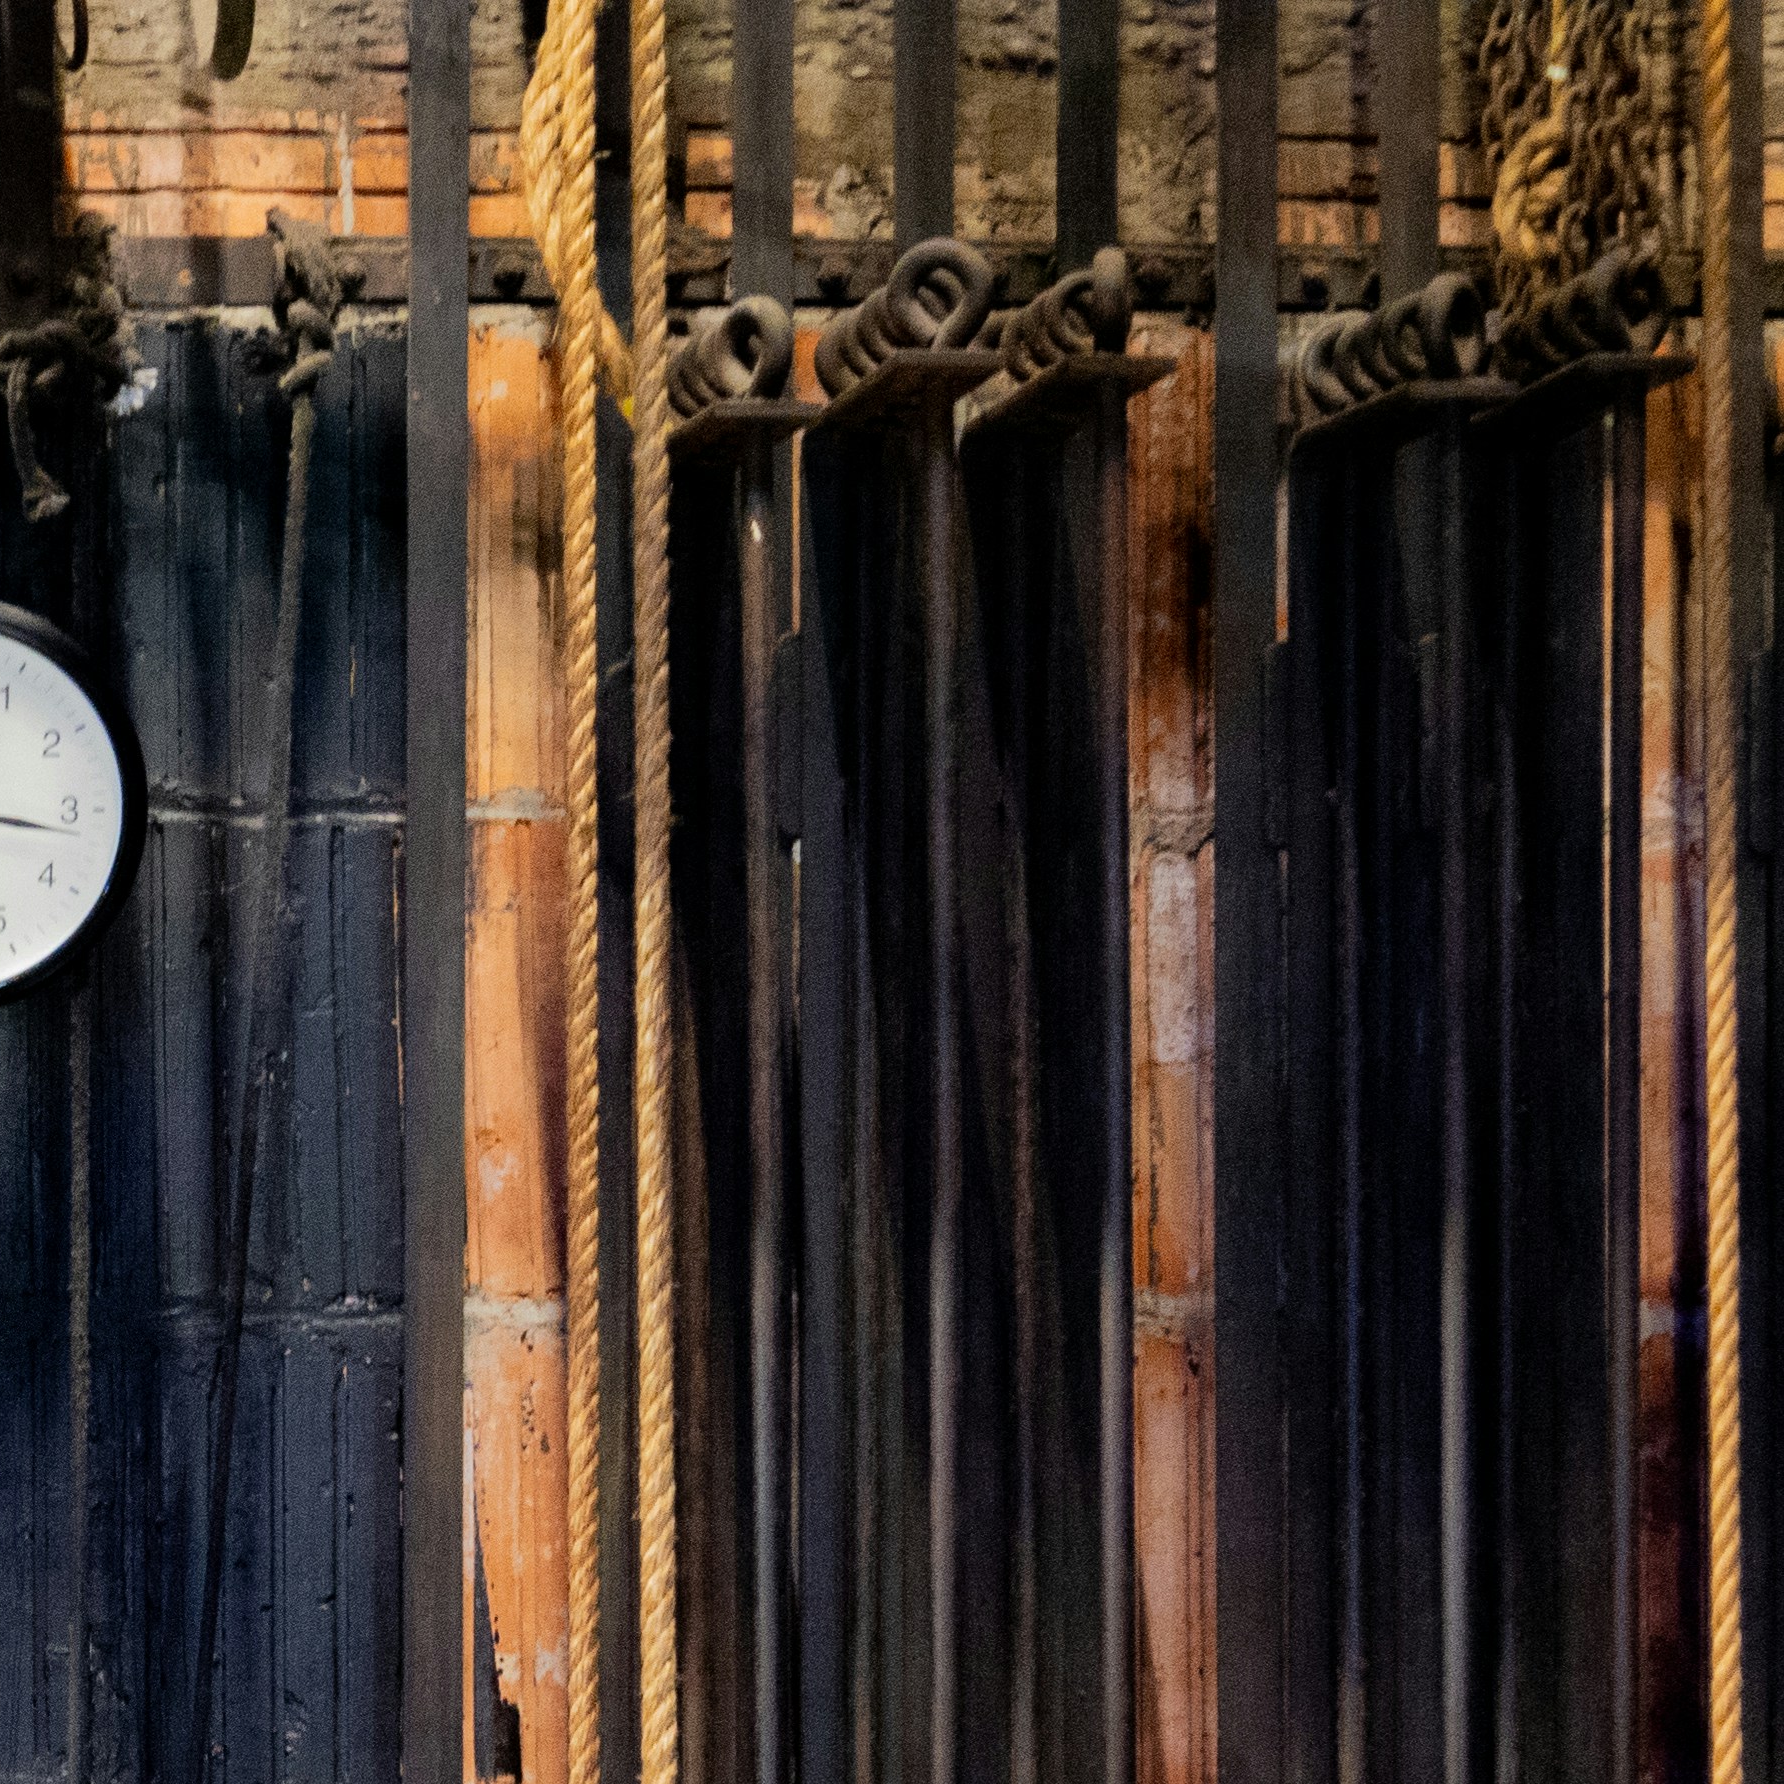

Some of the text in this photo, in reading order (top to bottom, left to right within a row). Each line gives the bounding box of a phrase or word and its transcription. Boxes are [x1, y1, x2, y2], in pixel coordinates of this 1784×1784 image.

[0, 685, 11, 711] 1
[42, 730, 62, 758] 2
[61, 795, 79, 823] 3
[38, 862, 56, 888] 4
